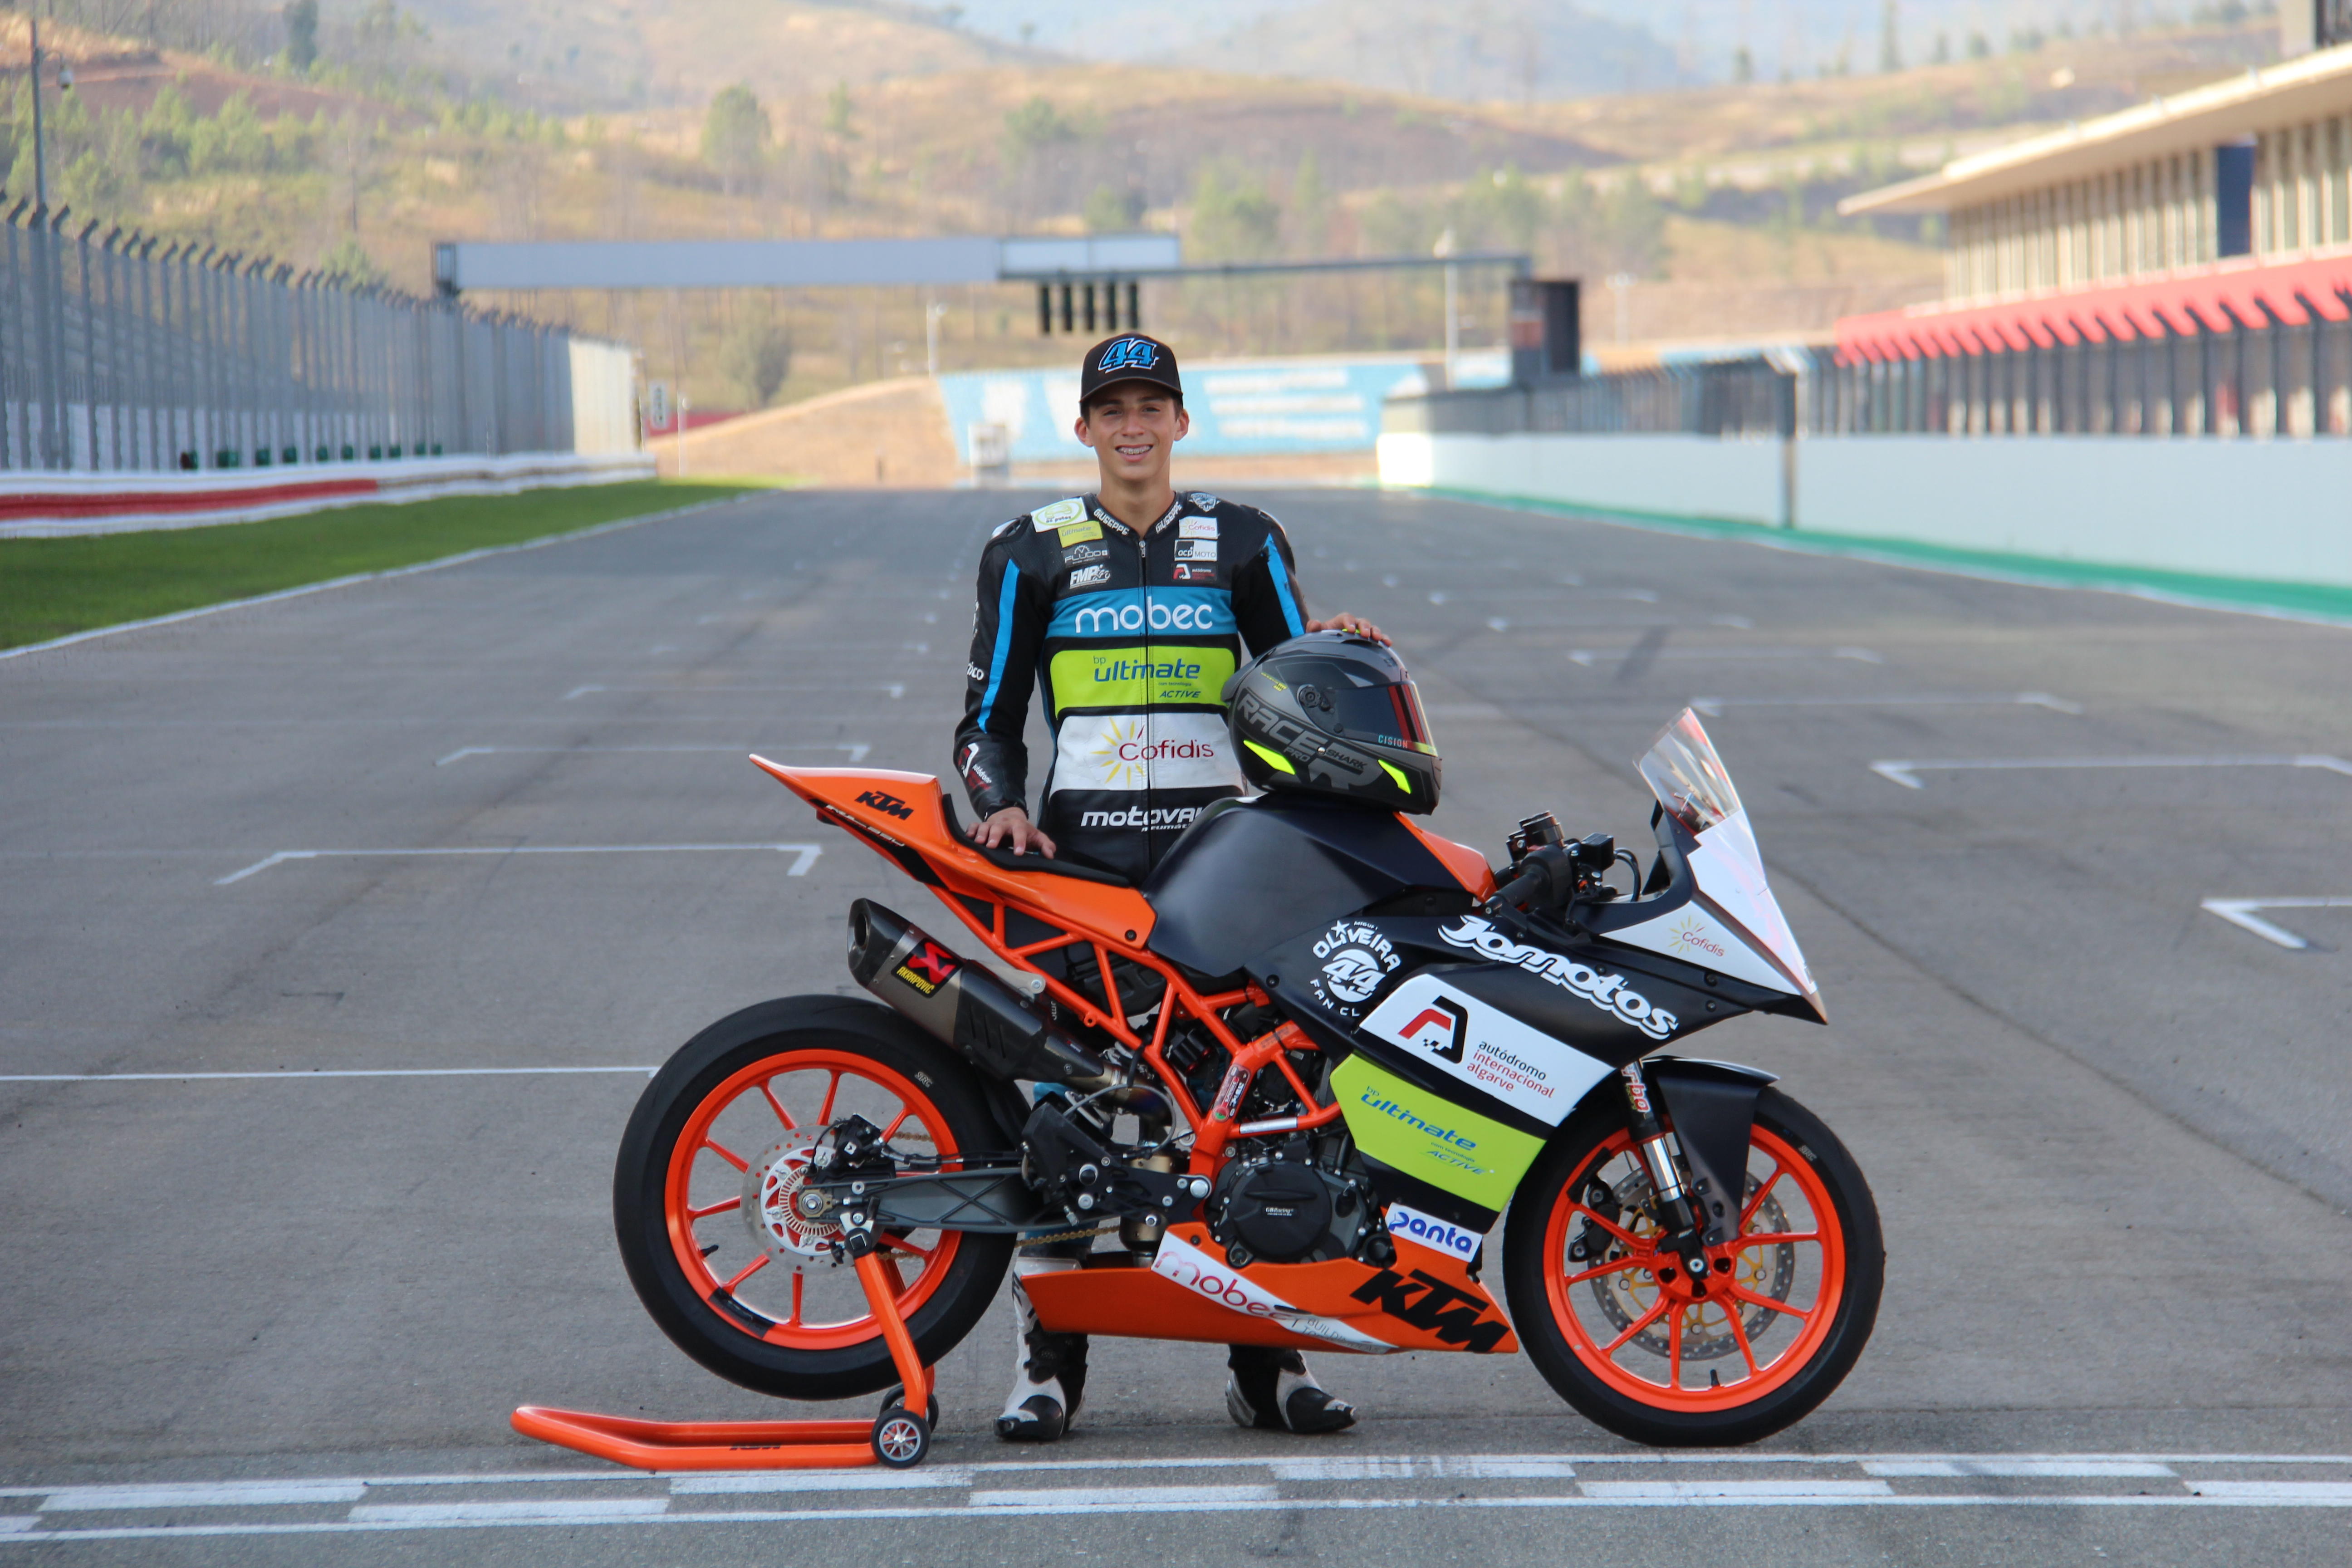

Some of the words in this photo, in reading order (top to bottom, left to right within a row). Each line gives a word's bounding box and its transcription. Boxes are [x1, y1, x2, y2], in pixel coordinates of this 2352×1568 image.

[1098, 338, 1159, 373] 44
[1075, 596, 1213, 633] mobec
[1093, 656, 1106, 665] bp
[1094, 658, 1200, 682] ultimate
[1237, 693, 1329, 755] RACE
[1119, 739, 1214, 761] Cofidis
[1284, 746, 1310, 763] PRO
[1326, 749, 1367, 769] SHARK
[854, 791, 914, 821] KTM
[1313, 927, 1401, 973] OLIVEIRA
[1682, 931, 1725, 957] Cofidis
[1322, 959, 1386, 995] 44
[1310, 979, 1334, 1009] FAN
[1473, 1049, 1555, 1098] internacional
[1479, 1041, 1547, 1080] autódromo
[1366, 1086, 1380, 1097] bp
[1467, 1062, 1514, 1092] algarve
[1361, 1093, 1477, 1151] ultimate
[1426, 1150, 1487, 1175] ACTIVE
[1431, 1142, 1444, 1150] com
[1445, 1147, 1475, 1162] tecnologia
[1388, 1211, 1473, 1254] panta
[1155, 1250, 1292, 1321] mobec
[1349, 1268, 1510, 1353] KTM
